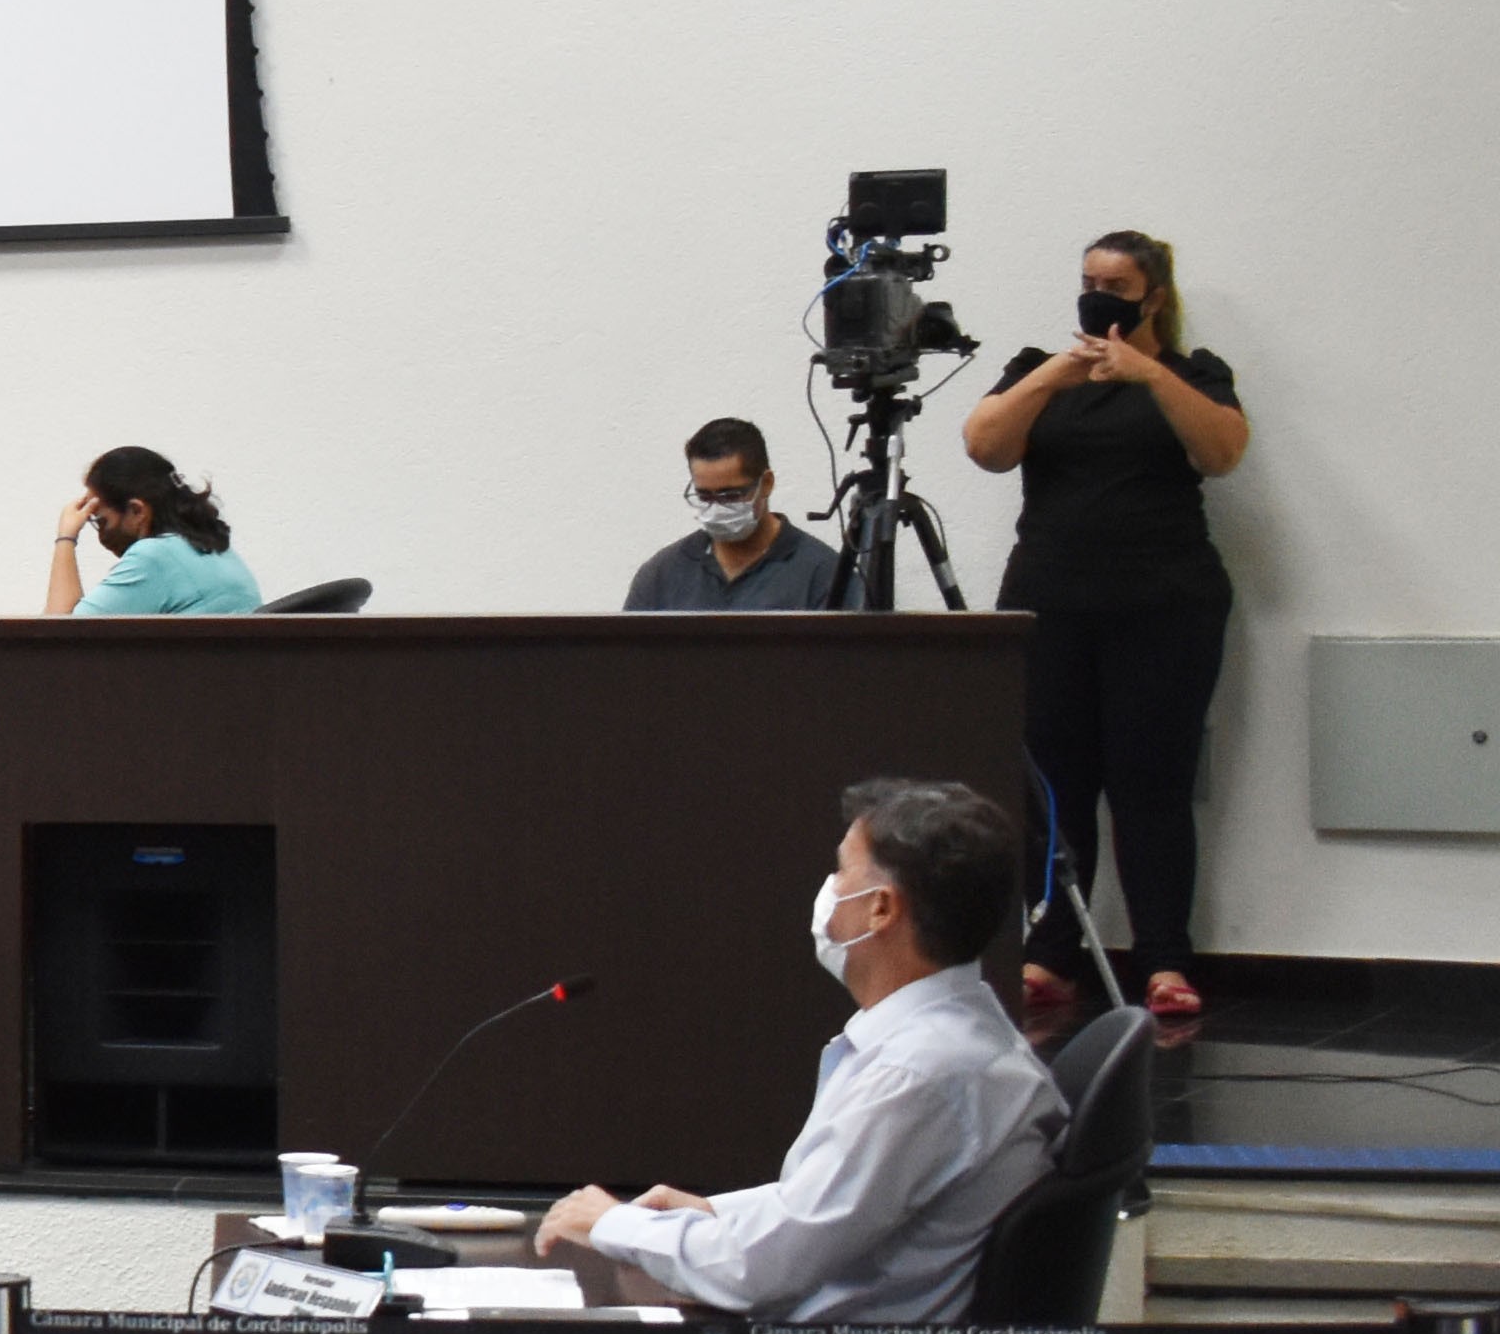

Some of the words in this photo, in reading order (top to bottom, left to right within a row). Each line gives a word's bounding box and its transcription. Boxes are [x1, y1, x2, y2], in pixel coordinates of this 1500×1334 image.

[31, 1310, 103, 1327] Câmara
[108, 1312, 201, 1333] Municipal
[207, 1315, 232, 1331] de
